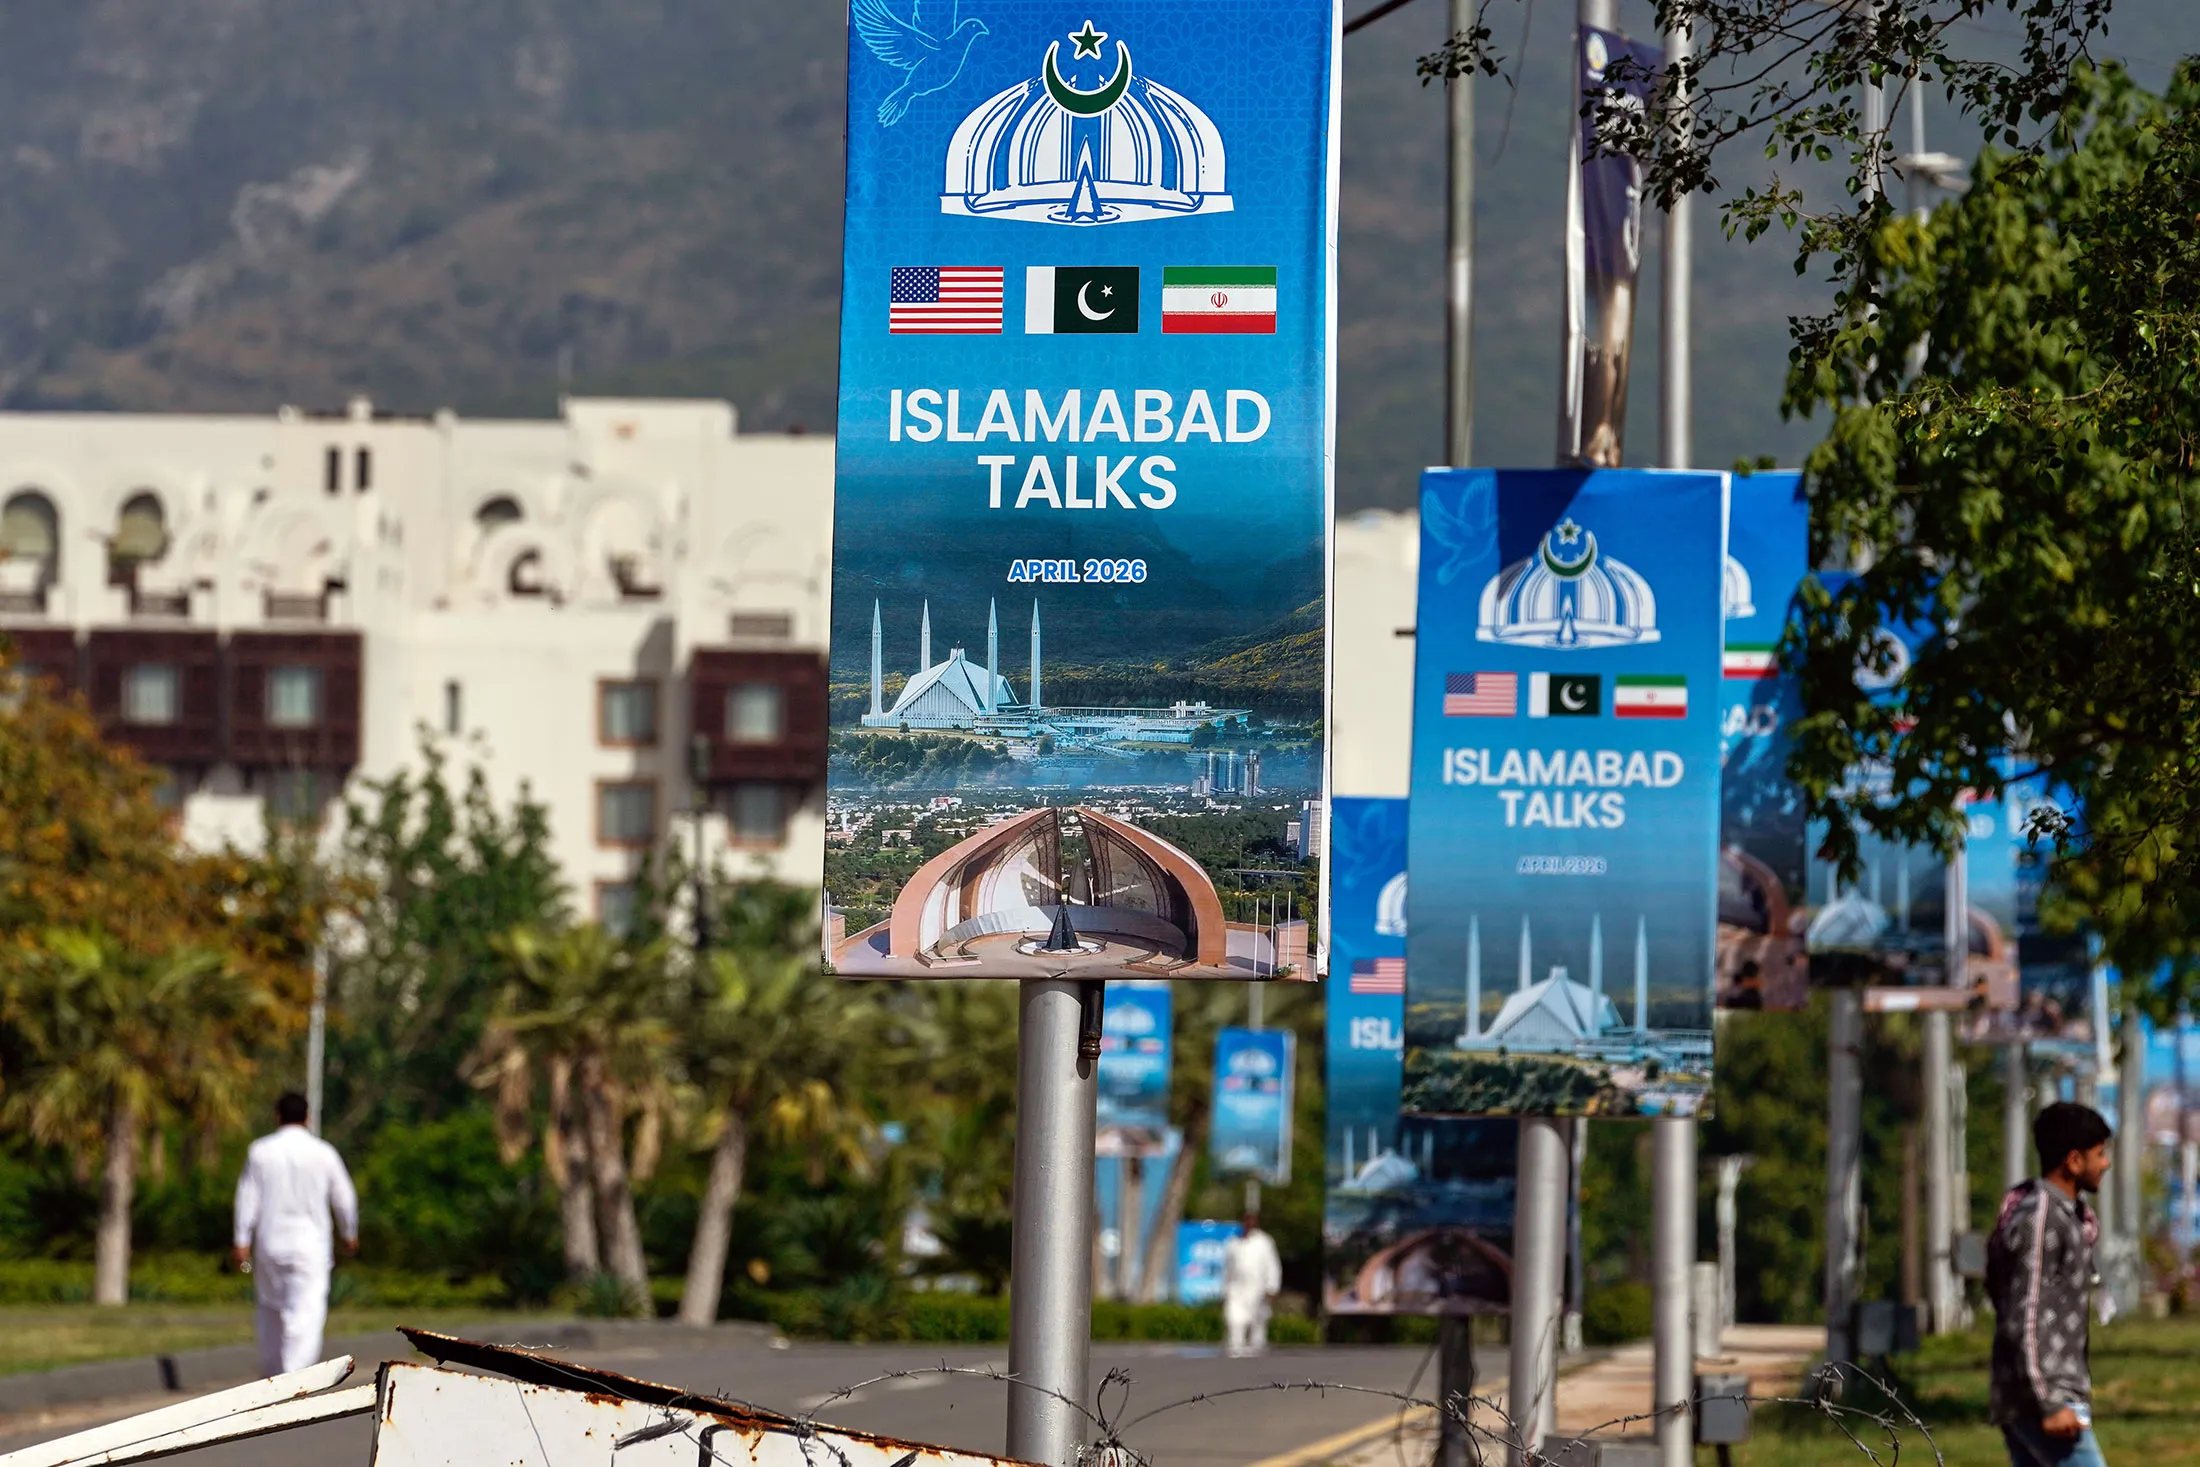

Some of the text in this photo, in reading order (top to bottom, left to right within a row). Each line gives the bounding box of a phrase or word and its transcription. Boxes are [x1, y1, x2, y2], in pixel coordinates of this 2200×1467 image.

[889, 388, 1272, 444] ISLAMABAD
[977, 454, 1177, 510] TALKS
[1007, 558, 1147, 583] APRIL 2026
[1443, 748, 1684, 788] ISLAMABAD
[1498, 790, 1626, 828] TALKS
[1517, 855, 1565, 875] APRIL
